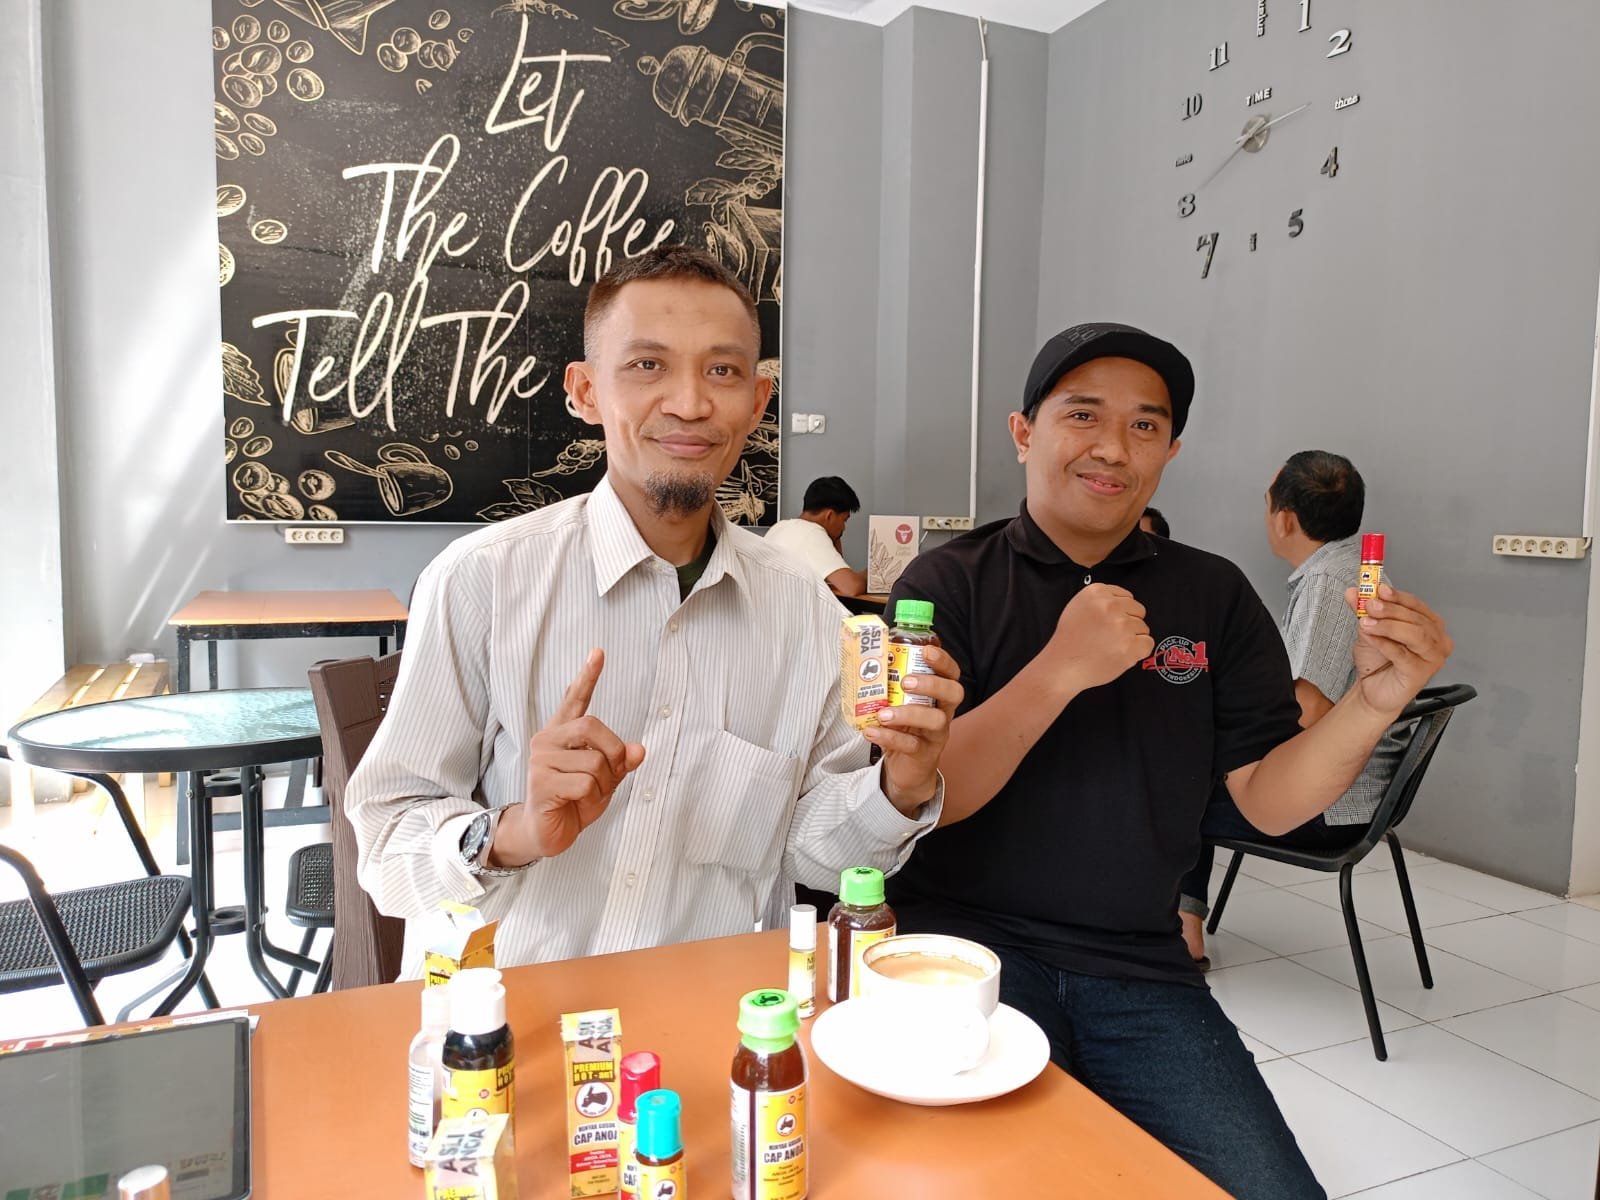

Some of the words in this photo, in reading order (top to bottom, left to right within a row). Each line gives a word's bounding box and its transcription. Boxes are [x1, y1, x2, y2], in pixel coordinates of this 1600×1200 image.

[1297, 0, 1312, 33] 1
[1208, 42, 1230, 72] 11
[1325, 28, 1352, 59] 2
[485, 13, 612, 152] Let
[1246, 87, 1272, 107] TIME
[1181, 93, 1203, 121] 10
[1320, 147, 1339, 178] 4
[343, 134, 479, 274] The
[505, 156, 675, 287] Coffee
[1288, 208, 1304, 238] 5
[1196, 232, 1219, 279] 7
[252, 275, 428, 431] Tell
[420, 281, 551, 425] The
[574, 1132, 592, 1146] CAP
[764, 1152, 782, 1163] CAP
